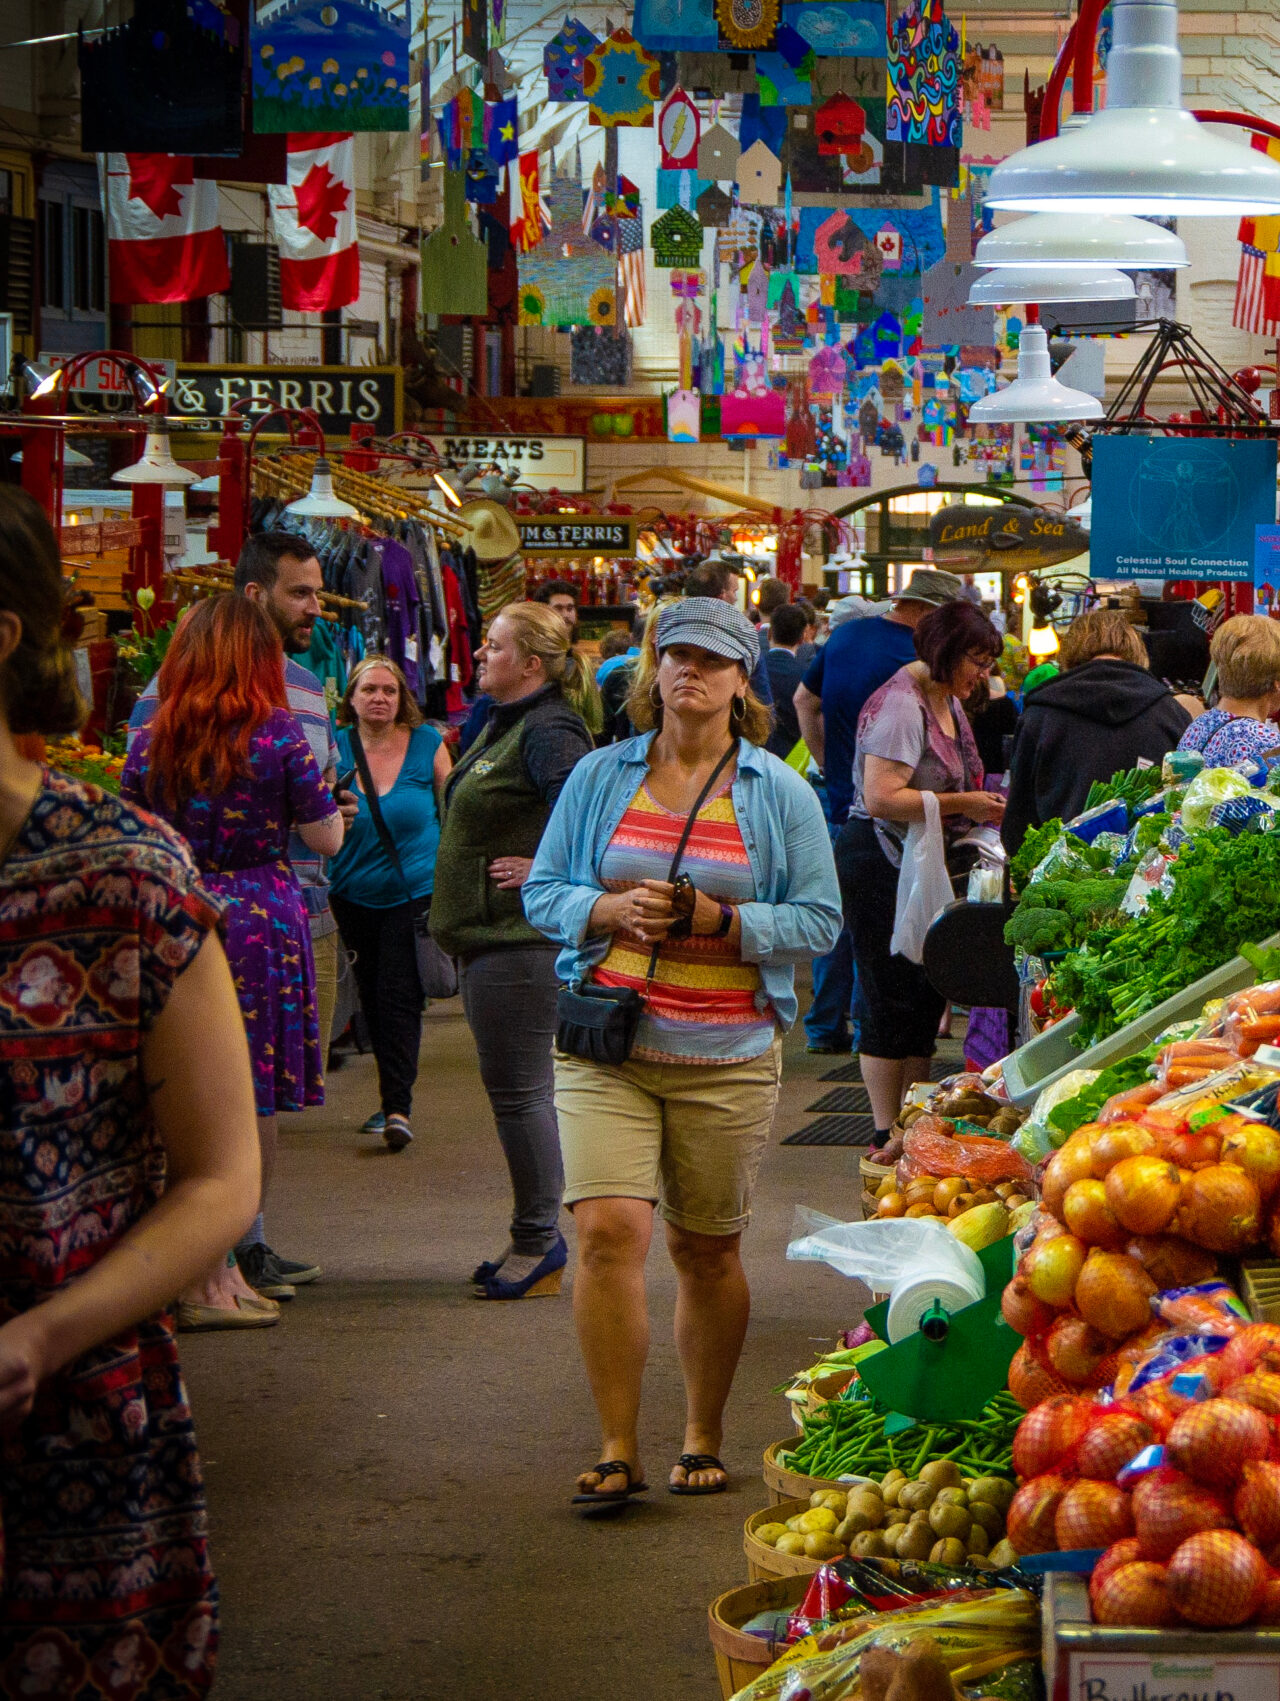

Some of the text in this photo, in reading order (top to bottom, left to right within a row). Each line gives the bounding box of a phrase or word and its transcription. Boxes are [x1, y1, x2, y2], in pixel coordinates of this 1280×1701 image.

[174, 378, 208, 413] &
[215, 377, 382, 423] FERRIS
[443, 438, 544, 460] MEATS
[543, 526, 556, 541] &
[558, 525, 624, 543] FERRIS
[939, 516, 1065, 543] Land & Sea
[1115, 556, 1249, 567] Celestial Soul Connection
[1116, 566, 1248, 577] All Natural Healing Products
